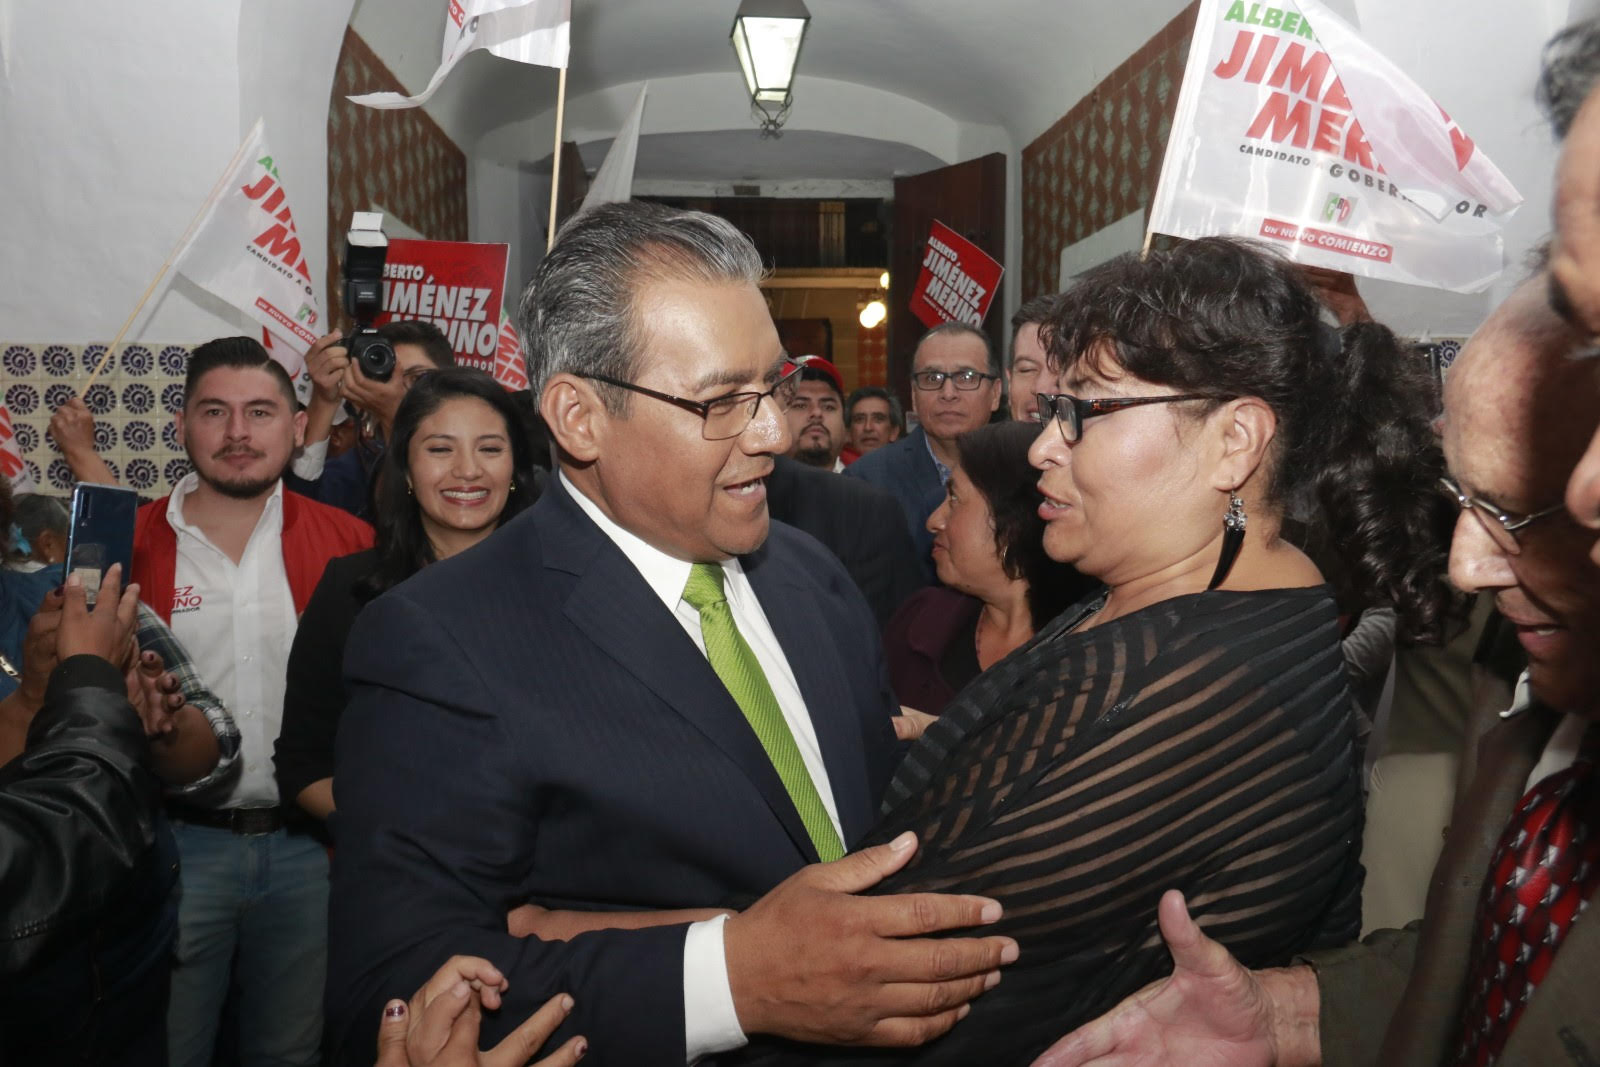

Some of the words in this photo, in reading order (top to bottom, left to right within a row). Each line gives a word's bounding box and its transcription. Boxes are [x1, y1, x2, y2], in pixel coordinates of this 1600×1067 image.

[1224, 0, 1320, 43] ALBER
[1245, 92, 1387, 175] MER
[1239, 144, 1311, 166] CANDIDATO
[928, 236, 957, 262] ALBERTO
[1264, 225, 1278, 235] UN
[1318, 233, 1389, 257] COMIENZO
[246, 245, 293, 279] CANDIDATO
[923, 249, 987, 310] JIMÉNEZ
[454, 358, 494, 372] NADOR
